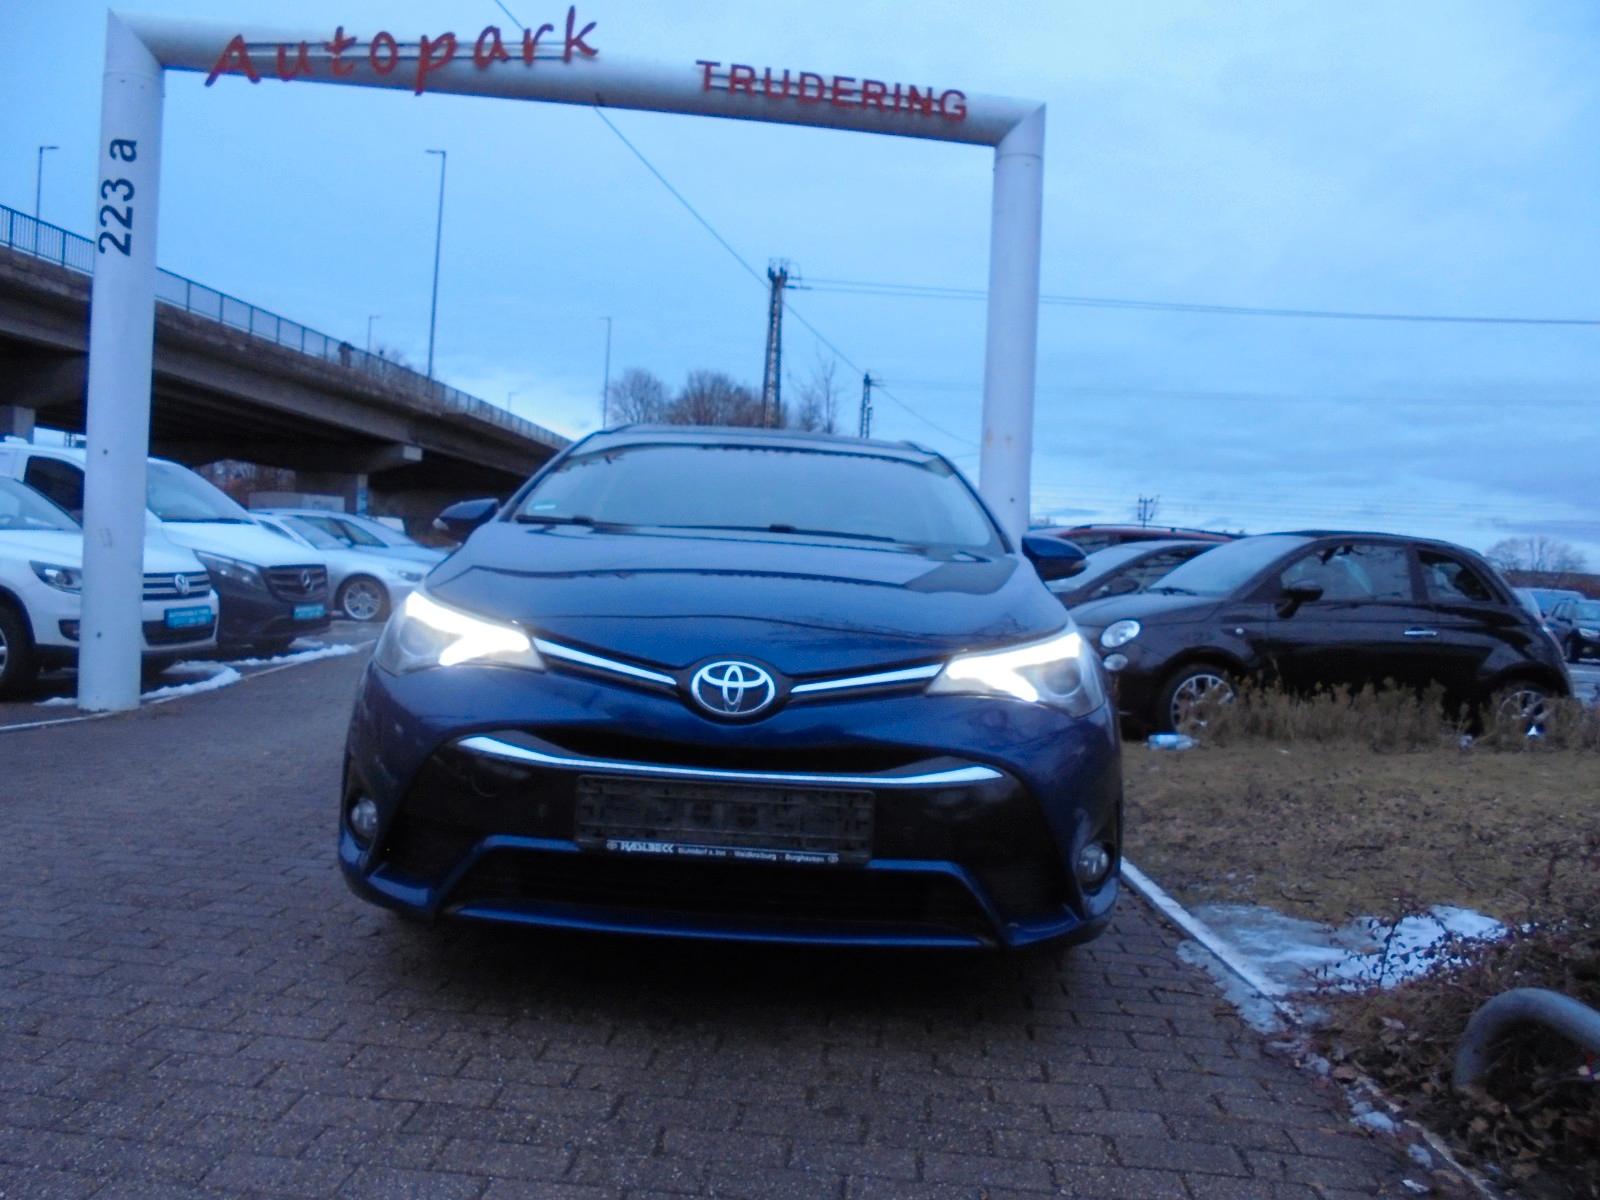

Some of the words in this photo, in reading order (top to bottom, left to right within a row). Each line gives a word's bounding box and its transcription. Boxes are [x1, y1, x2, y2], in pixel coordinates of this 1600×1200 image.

[204, 5, 599, 96] Autopark
[695, 59, 967, 122] TRUDERING
[109, 139, 137, 162] a
[98, 178, 135, 256] 223
